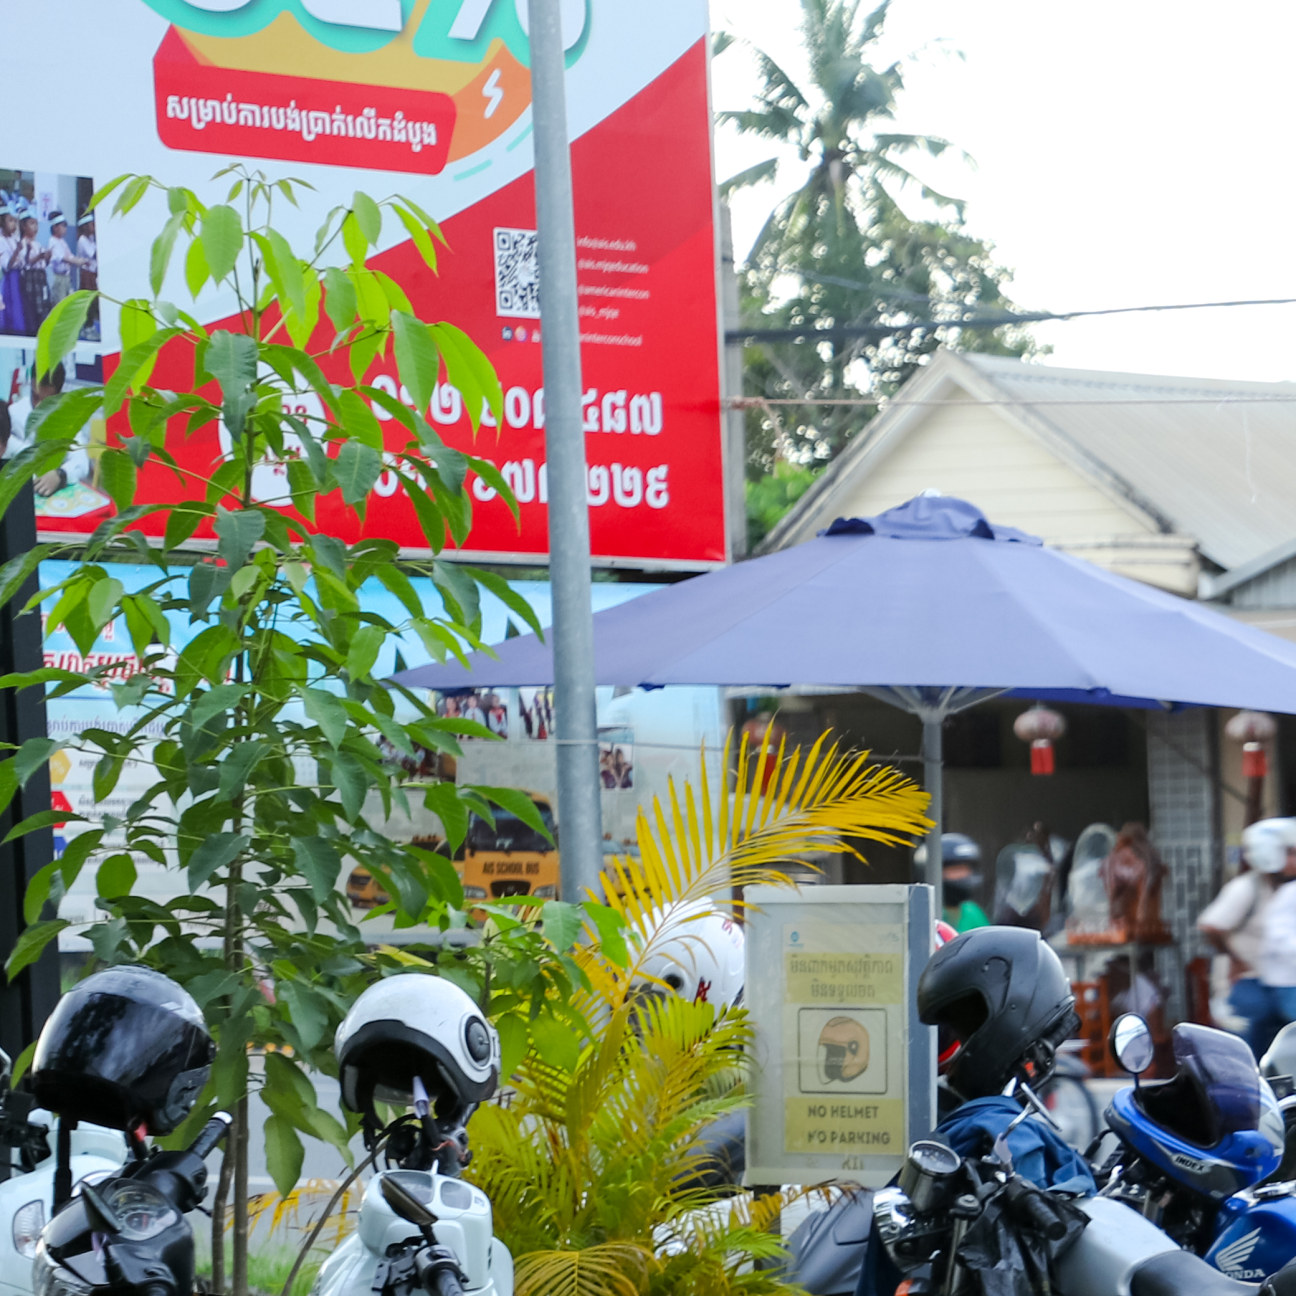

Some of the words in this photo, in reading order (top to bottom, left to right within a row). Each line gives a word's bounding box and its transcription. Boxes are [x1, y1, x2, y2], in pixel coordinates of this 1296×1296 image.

[165, 93, 437, 152] សម្រាប់ការបង់ប្រាក់លើកដំបូង
[496, 861, 523, 875] SCHOOL
[807, 1105, 827, 1118] NO
[831, 1105, 879, 1119] HELMET
[807, 1130, 827, 1143] NO
[830, 1131, 891, 1145] PARKING
[1175, 1155, 1205, 1172] INDEX
[1223, 1268, 1266, 1280] ONDA
